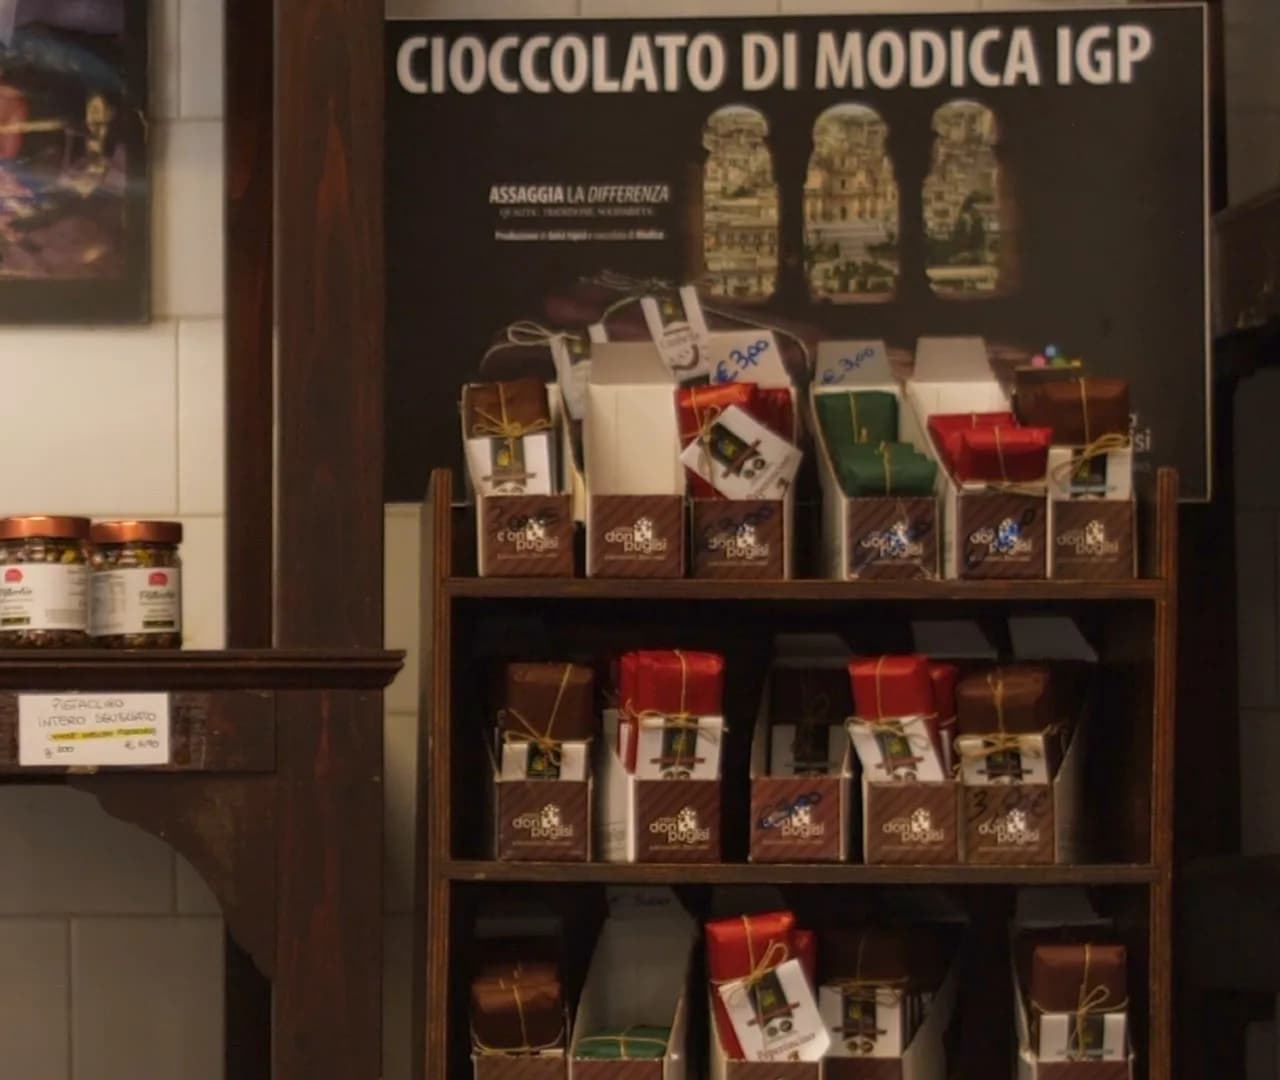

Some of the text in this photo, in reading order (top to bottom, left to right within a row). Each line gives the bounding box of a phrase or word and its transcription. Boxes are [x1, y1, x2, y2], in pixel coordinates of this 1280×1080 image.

[396, 25, 1152, 94] CIOCCOLATO DI MODICA IGP
[489, 184, 669, 204] ASSAGGIA LA DIFFERENZA
[716, 360, 738, 383] €
[649, 818, 678, 832] don
